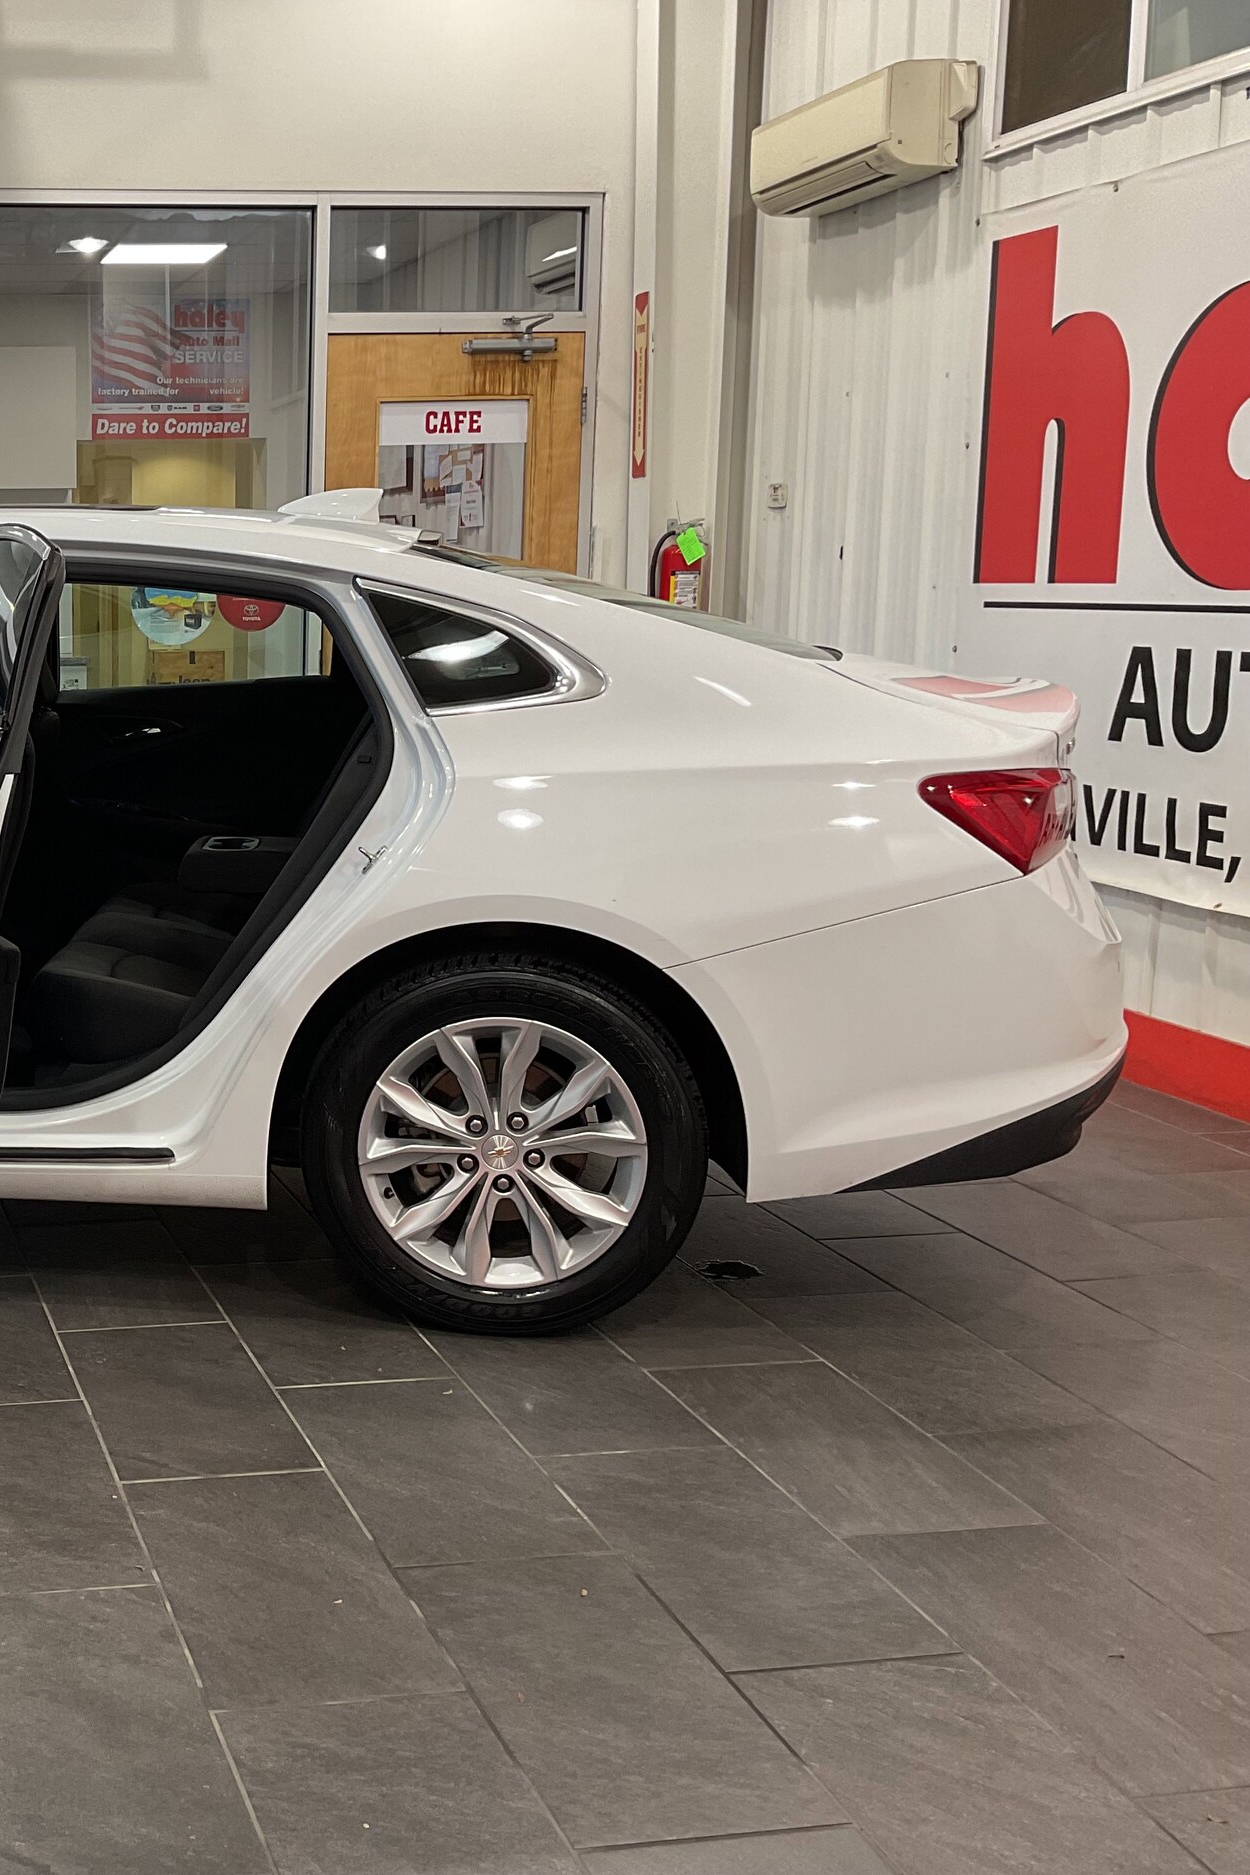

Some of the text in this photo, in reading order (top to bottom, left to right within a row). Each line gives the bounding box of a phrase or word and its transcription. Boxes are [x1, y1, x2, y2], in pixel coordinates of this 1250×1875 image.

[174, 304, 245, 333] haley
[174, 350, 243, 363] SERVICE
[157, 376, 172, 385] Our
[98, 387, 179, 397] factory trained for
[96, 417, 247, 437] Dare to Compare!
[425, 410, 482, 434] CAFE
[1107, 645, 1250, 753] AU
[1070, 783, 1242, 884] VILLE,
